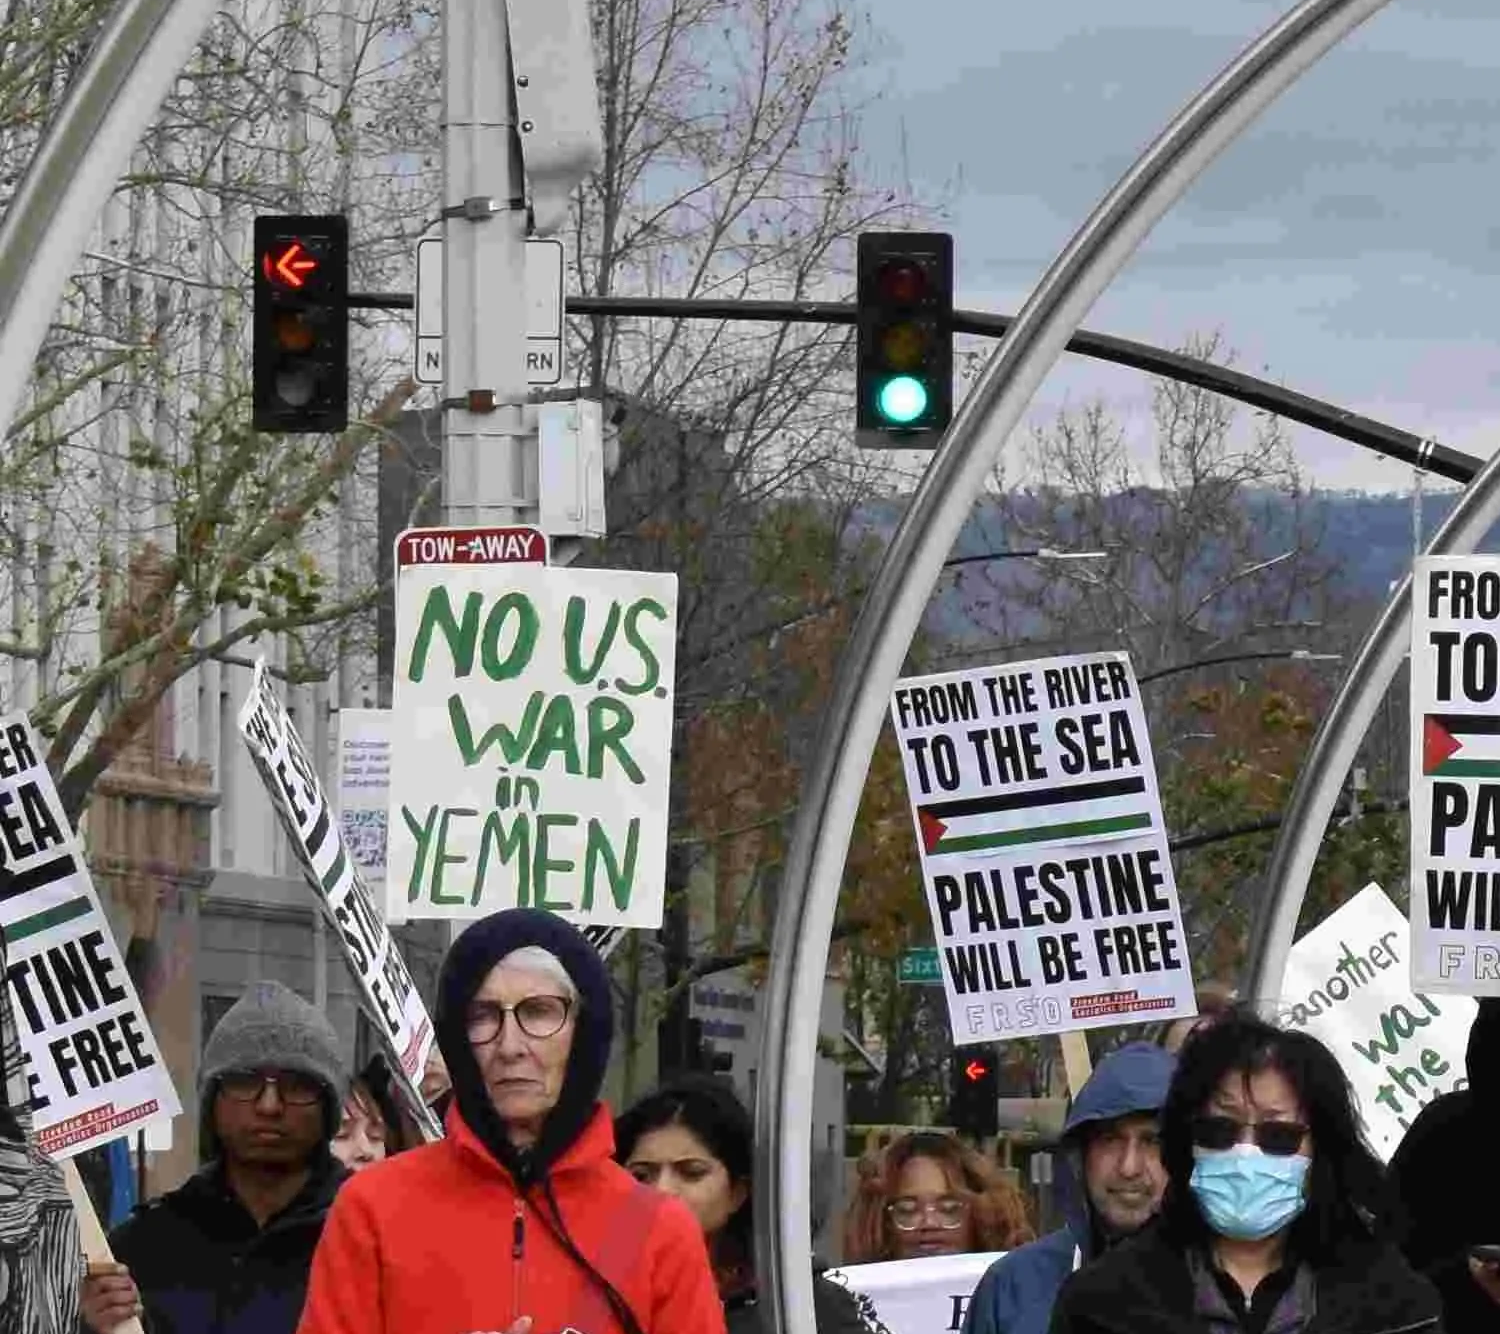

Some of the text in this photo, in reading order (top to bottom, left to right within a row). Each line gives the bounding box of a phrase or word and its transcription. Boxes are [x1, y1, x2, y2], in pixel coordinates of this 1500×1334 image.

[407, 533, 536, 563] TOW-AWAY
[408, 584, 542, 683] NO
[1429, 631, 1498, 703] TO
[896, 661, 1132, 729] FROM THE RIVER
[446, 689, 647, 786] WAR
[906, 709, 1142, 795] TO THE SEA
[0, 780, 65, 863] EA
[494, 765, 541, 811] in
[400, 803, 641, 914] YEMEN
[933, 849, 1171, 937] PALESTINE
[902, 959, 944, 976] Six
[945, 921, 1182, 996] WILL BE FREE
[1290, 931, 1400, 1026] another
[48, 1010, 156, 1099] FREE
[1374, 1048, 1451, 1114] the
